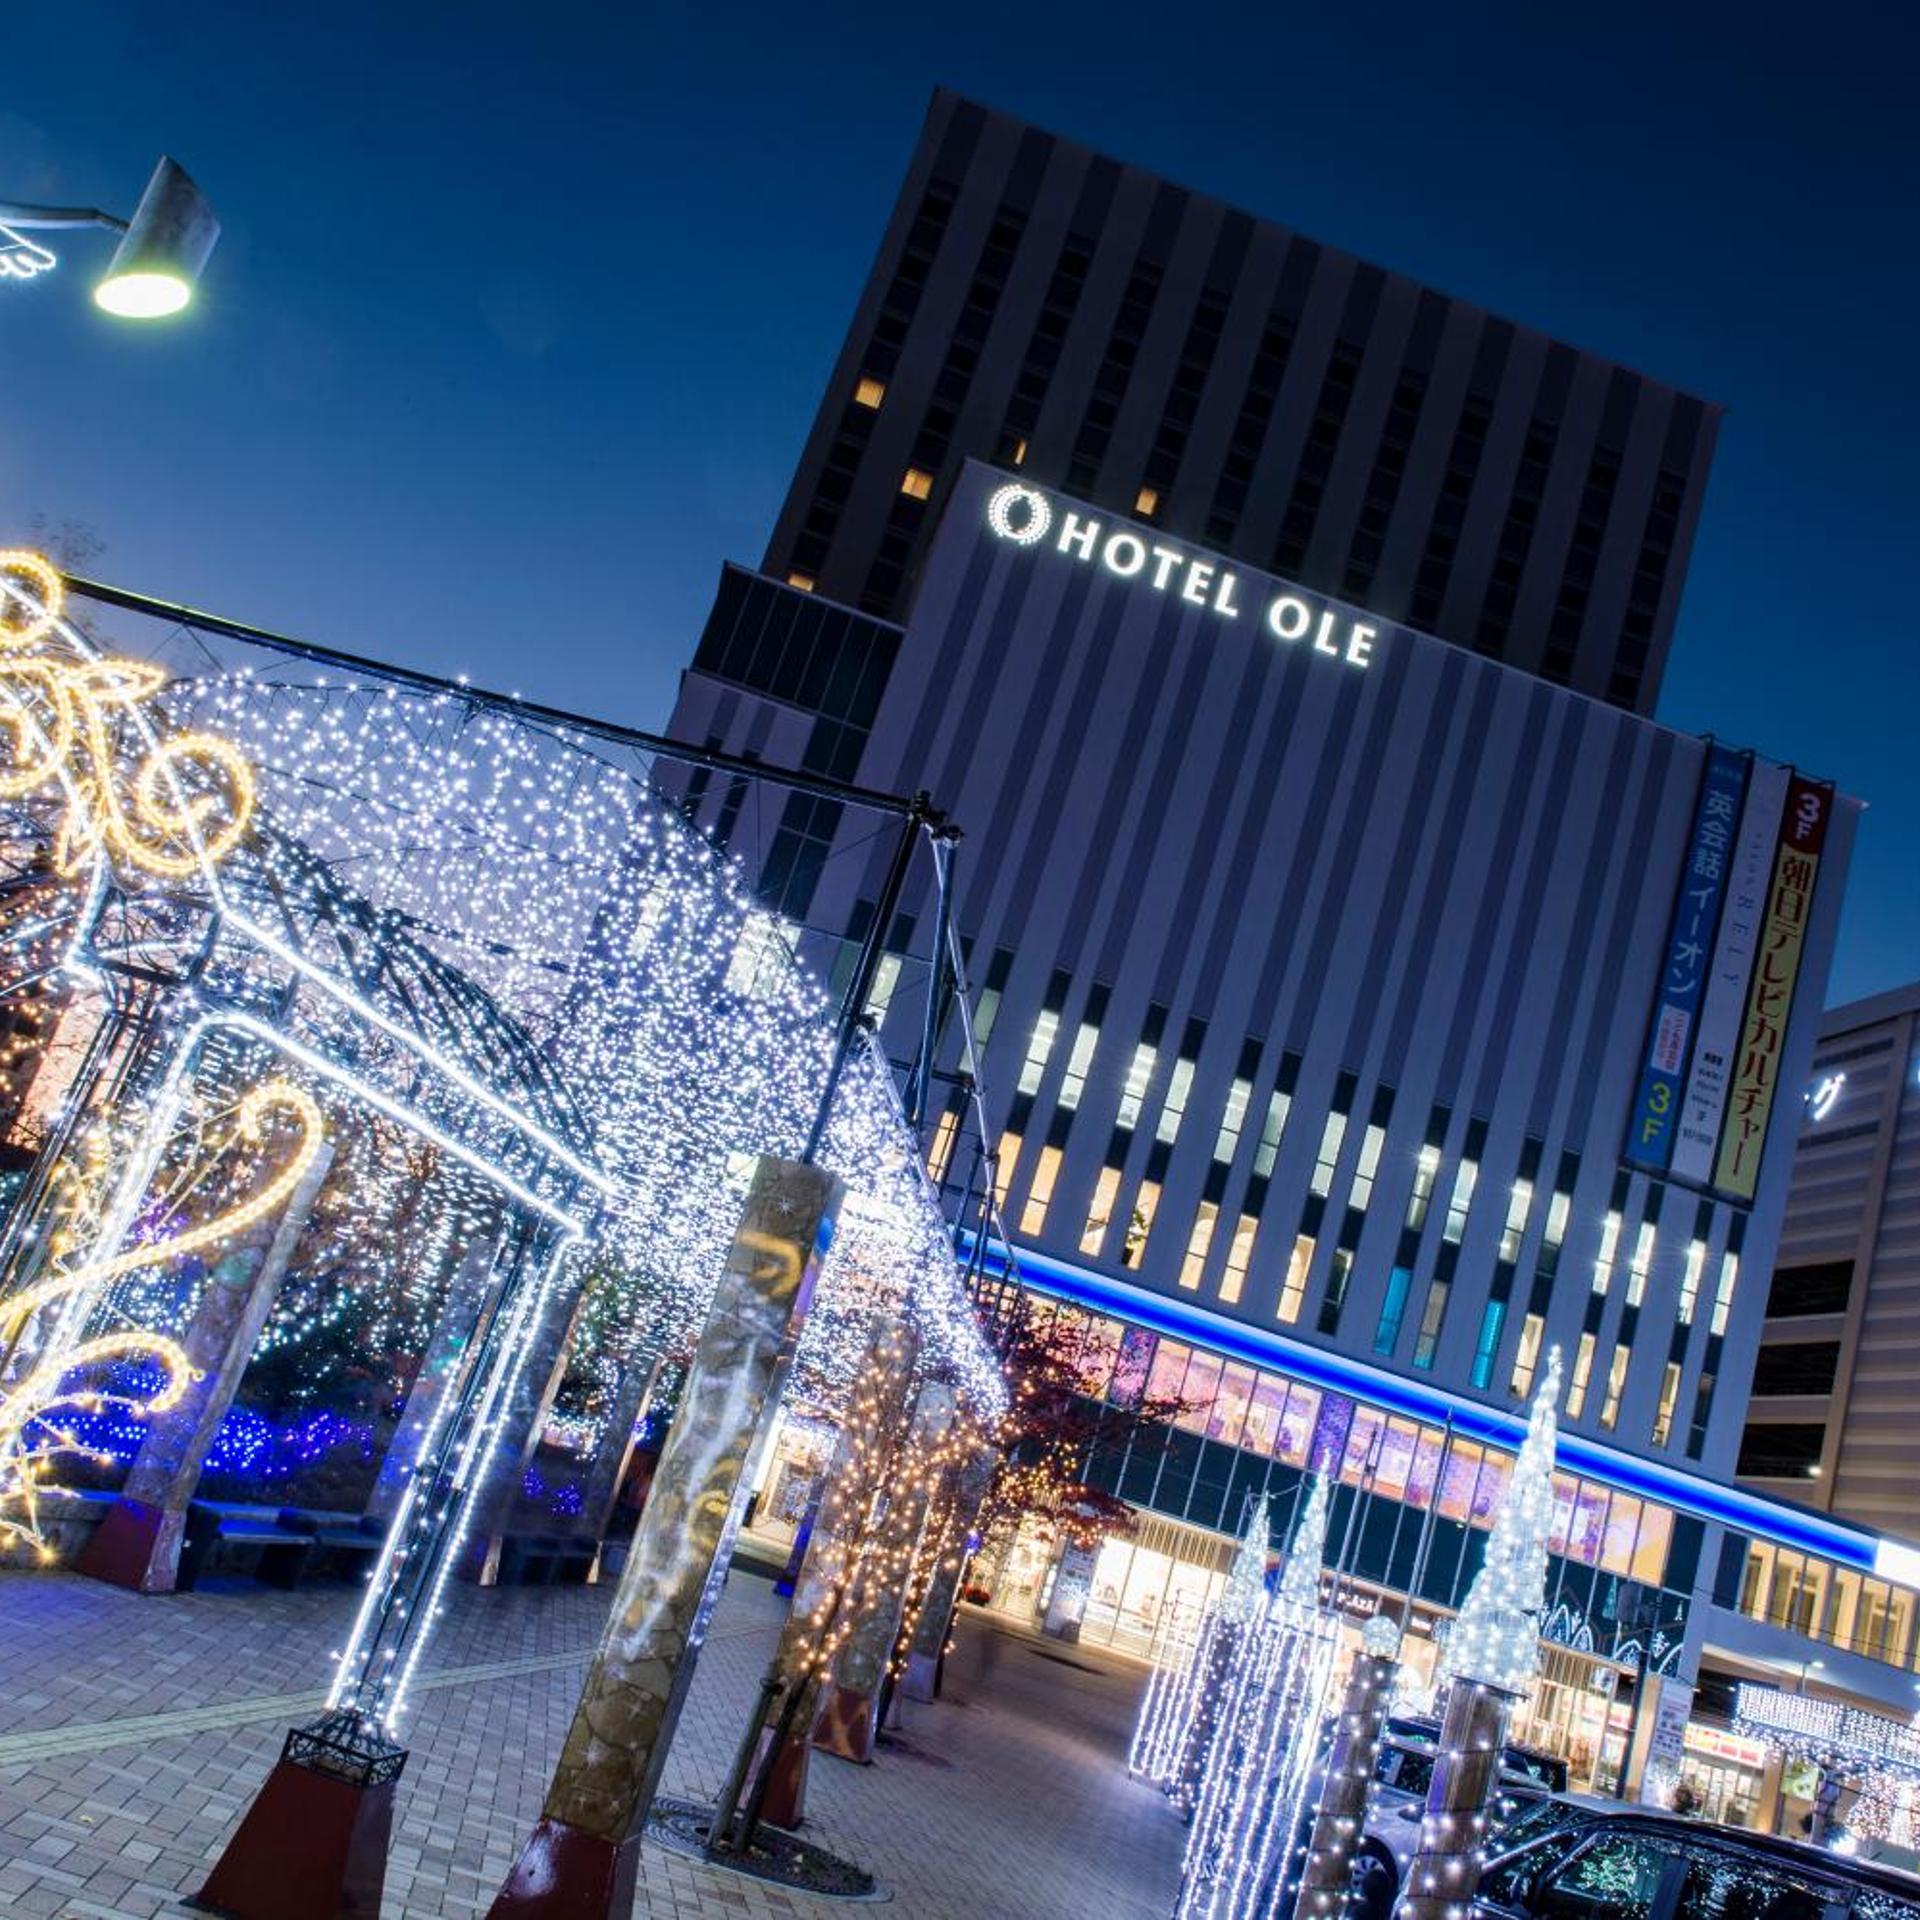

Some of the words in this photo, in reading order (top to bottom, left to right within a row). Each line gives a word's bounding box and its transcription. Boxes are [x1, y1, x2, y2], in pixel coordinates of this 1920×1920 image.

[1056, 513, 1239, 617] HOTEL
[1268, 596, 1377, 669] OLE
[1731, 856, 1813, 1176] 朝日テレビカルチャー
[1643, 1083, 1671, 1145] 3F
